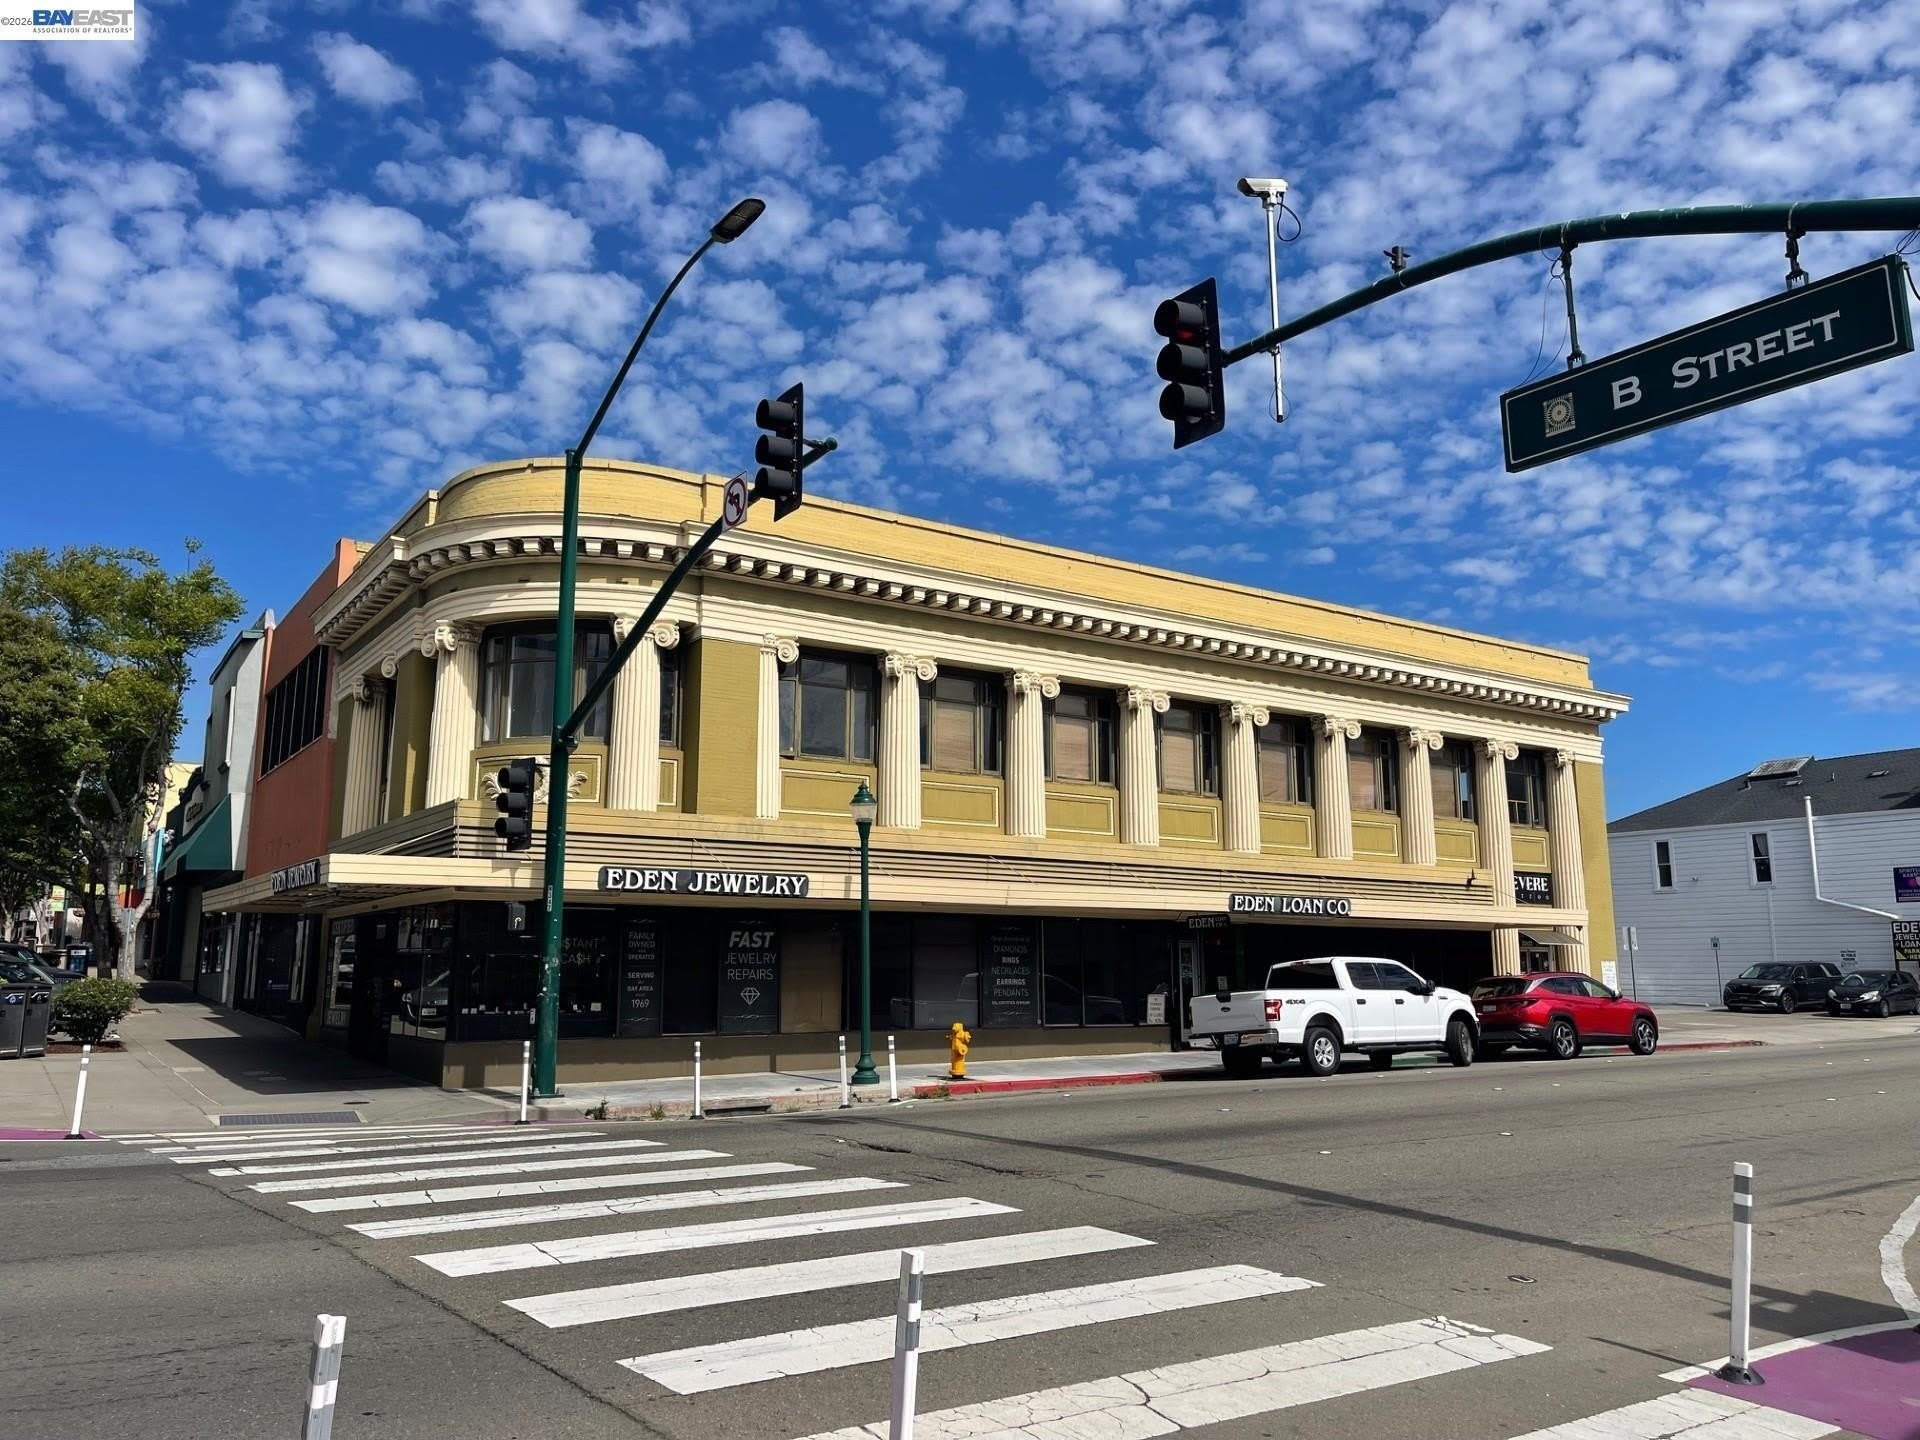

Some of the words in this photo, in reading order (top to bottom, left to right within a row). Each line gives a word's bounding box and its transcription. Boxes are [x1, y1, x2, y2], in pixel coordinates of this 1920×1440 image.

[1611, 376, 1642, 410] B
[1672, 310, 1841, 389] STREET
[606, 868, 679, 891] EDEN
[688, 872, 807, 896] JEWELRY
[1513, 876, 1549, 891] EVERE
[1234, 896, 1275, 912] EDEN
[1282, 898, 1323, 914] LOAN
[1327, 900, 1350, 915] CO.
[1188, 917, 1215, 928] EDEN
[729, 931, 774, 948] FAST
[1893, 933, 1920, 941] JEWEL
[724, 952, 777, 964] JEWELRY
[727, 968, 774, 980] REPAIRS
[631, 999, 650, 1008] 1969
